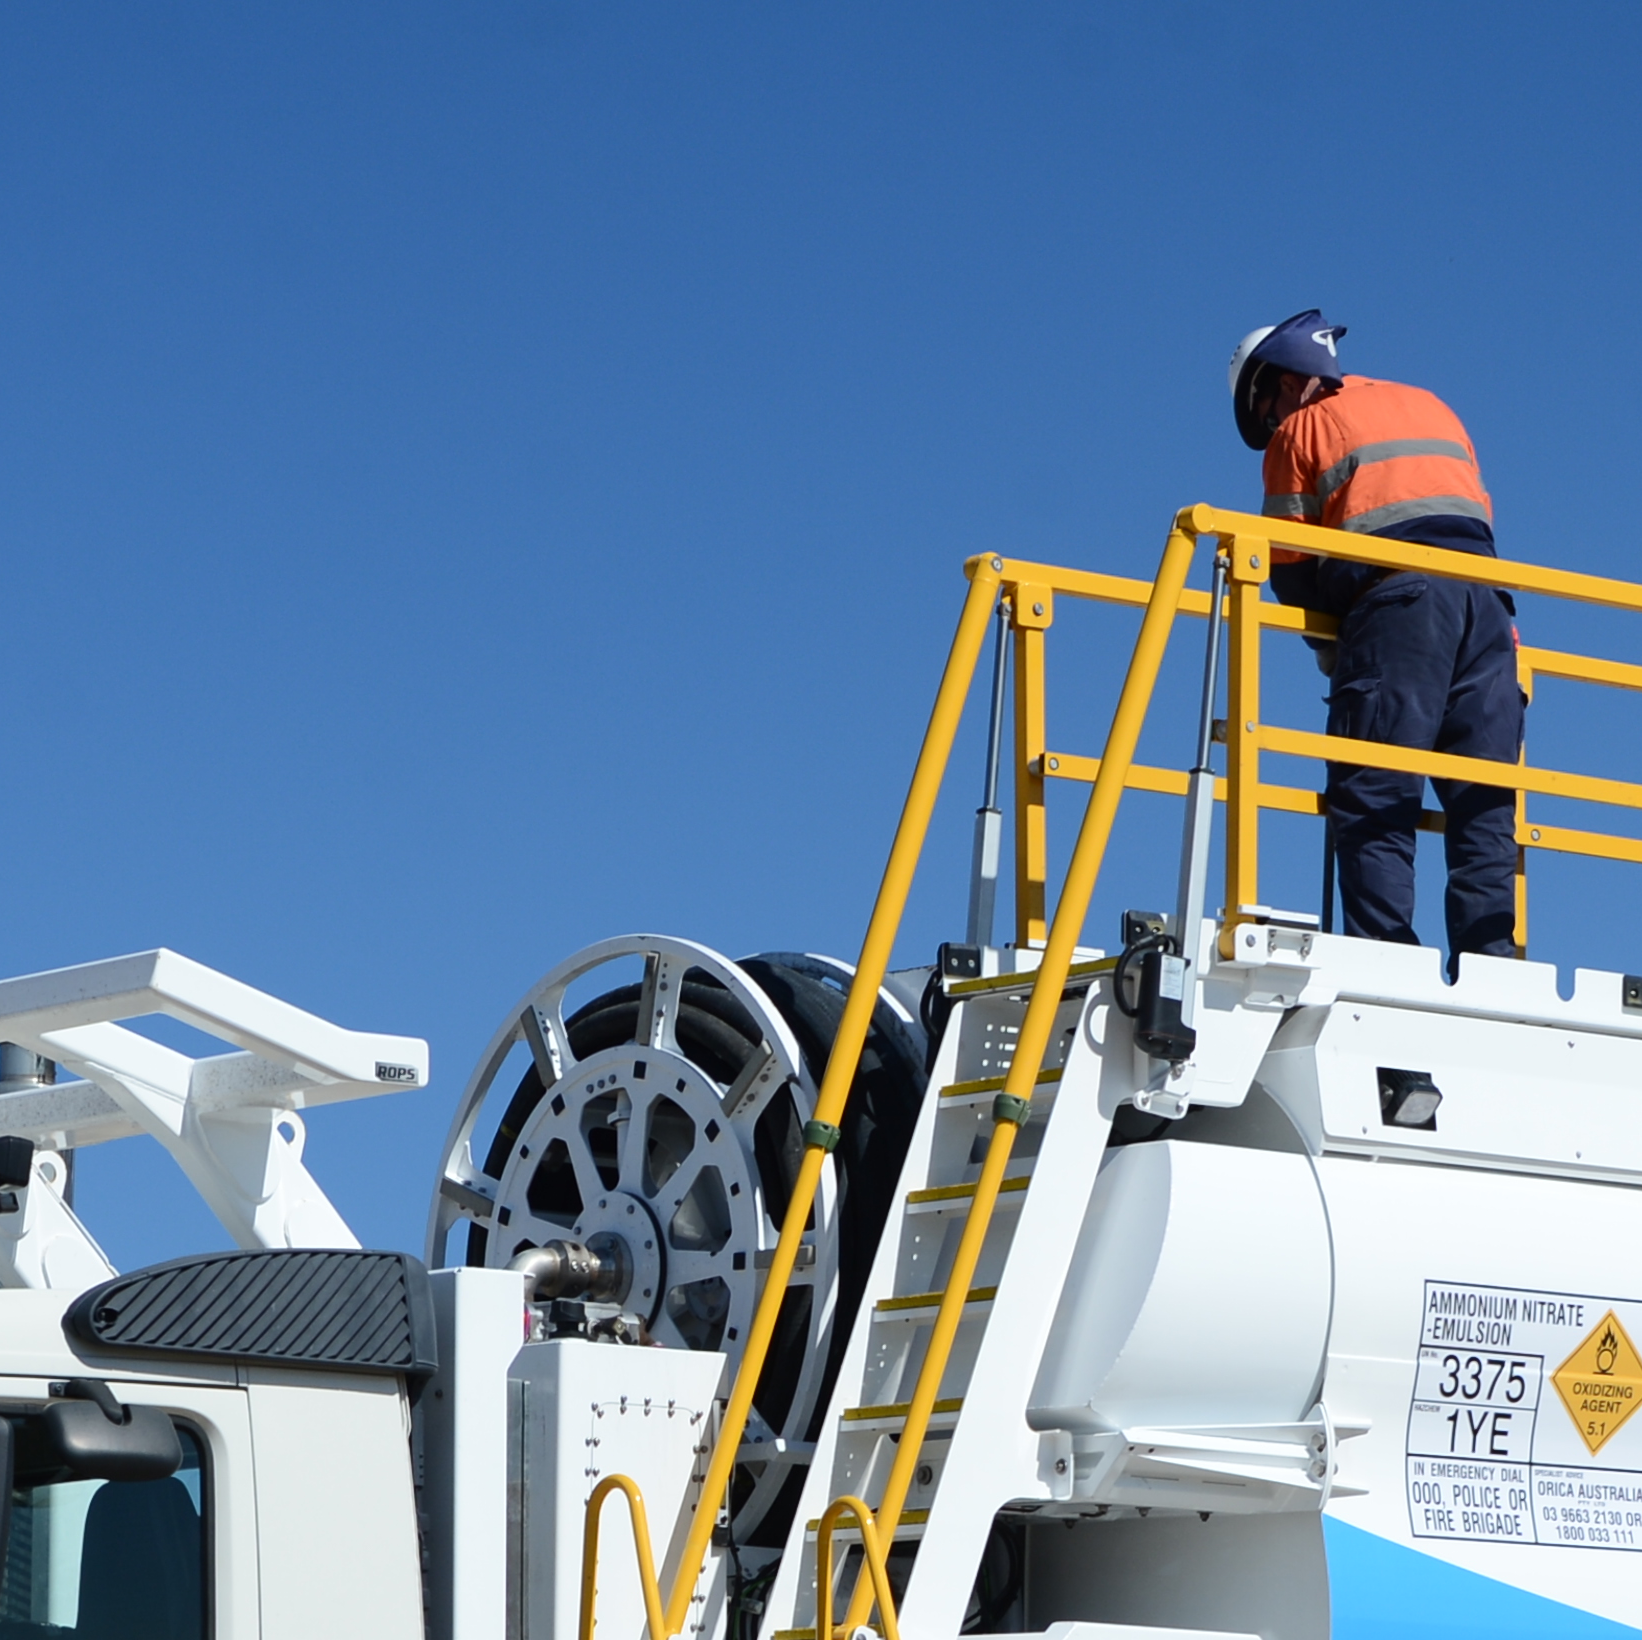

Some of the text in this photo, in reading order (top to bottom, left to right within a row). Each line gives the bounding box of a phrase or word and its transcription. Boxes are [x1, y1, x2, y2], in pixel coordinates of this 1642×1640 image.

[377, 1065, 416, 1080] ROPS
[1428, 1290, 1584, 1327] AMMONIUM NITRATE
[1427, 1317, 1512, 1346] -EMULSION
[1439, 1354, 1526, 1403] 3375
[1572, 1382, 1633, 1399] OXIDIZING
[1580, 1398, 1622, 1414] AGENT
[1447, 1408, 1512, 1455] 1YE
[1587, 1421, 1606, 1436] 5.1
[1414, 1462, 1524, 1483] IN EMERGENCY DIAL
[1453, 1484, 1501, 1509] POLICE
[1508, 1488, 1528, 1511] OR
[1537, 1480, 1574, 1497] ORICA
[1424, 1508, 1523, 1536] FIRE BRIGADE
[1542, 1506, 1642, 1527] 03 9663 2130 OR
[1555, 1525, 1634, 1544] 1800 033 111
